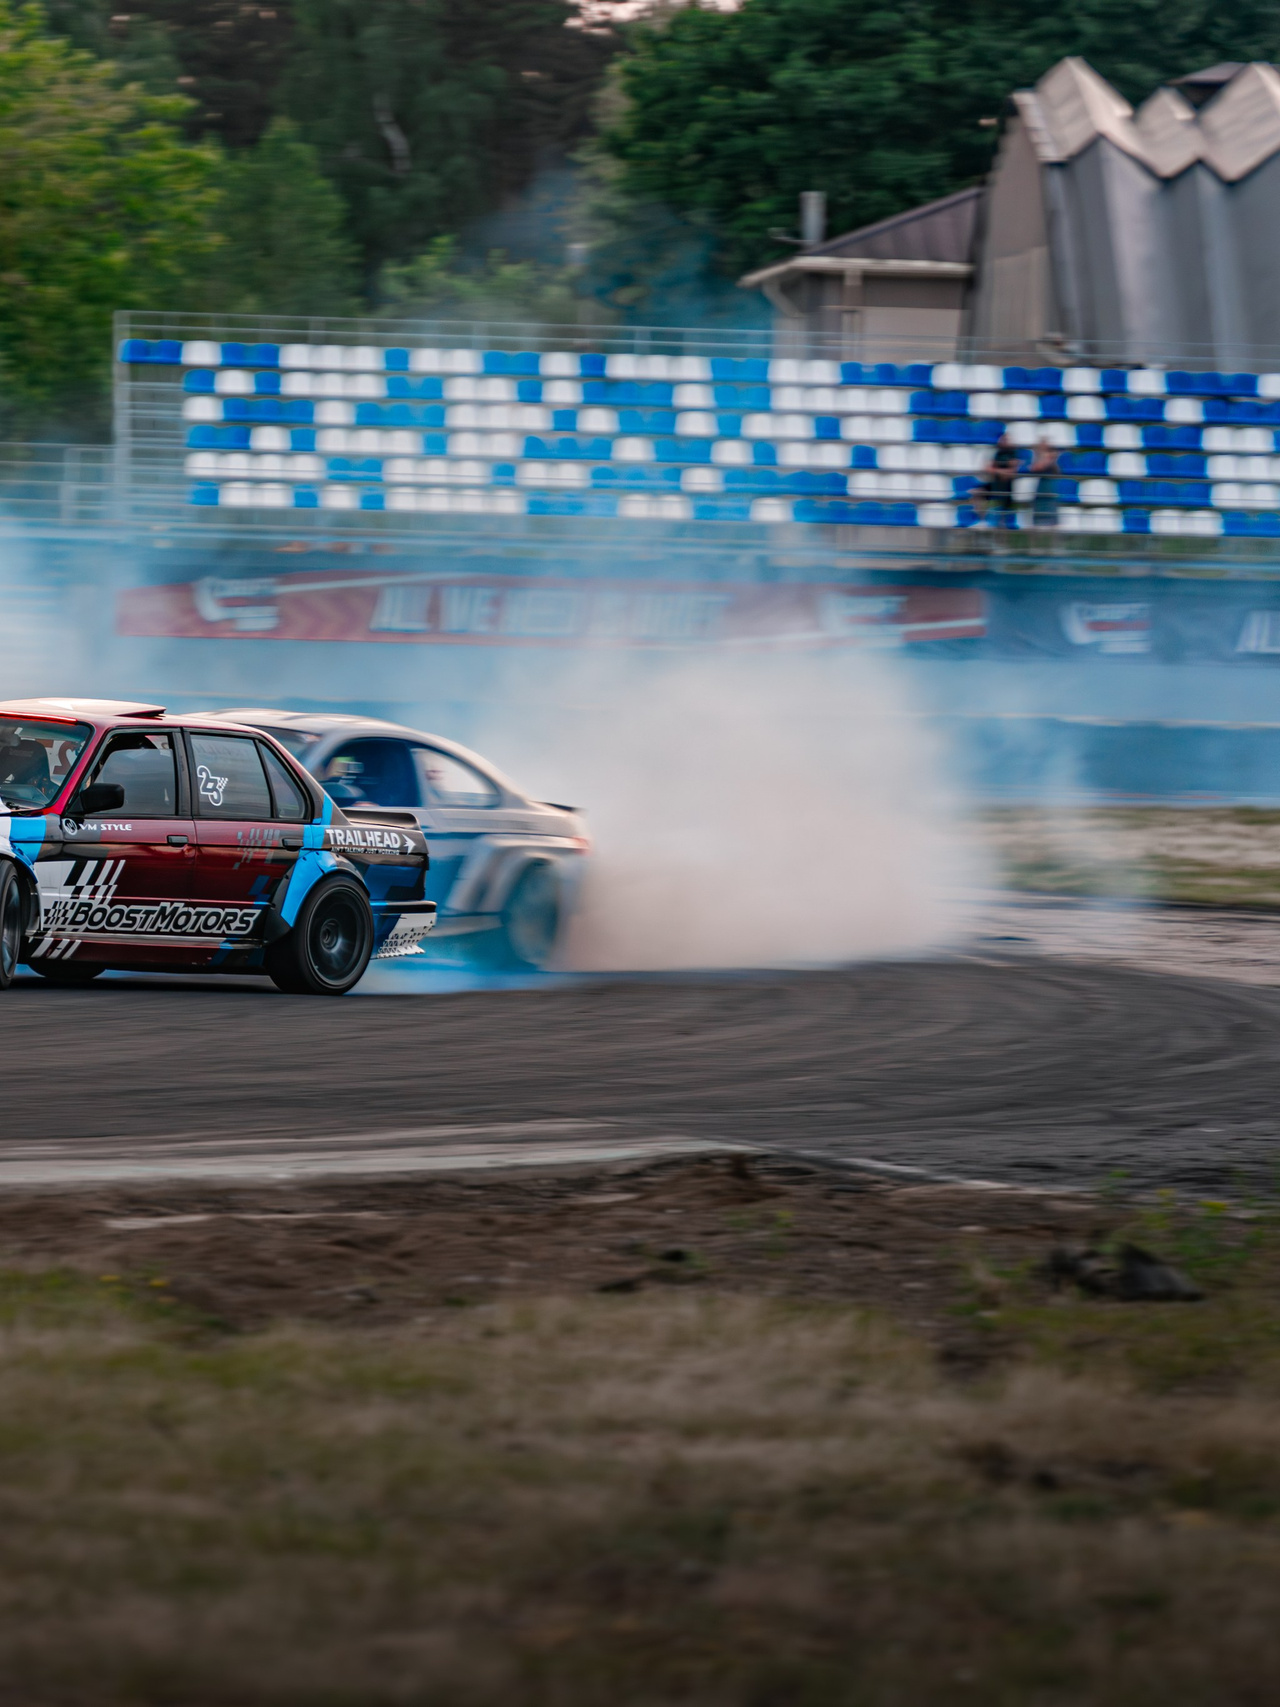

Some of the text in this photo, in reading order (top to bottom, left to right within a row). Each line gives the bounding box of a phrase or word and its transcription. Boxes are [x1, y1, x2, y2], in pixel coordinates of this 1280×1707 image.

[79, 823, 132, 831] VM STYLE
[325, 829, 401, 848] TRAILHEAD
[65, 901, 261, 934] BOOSTMOTORS
